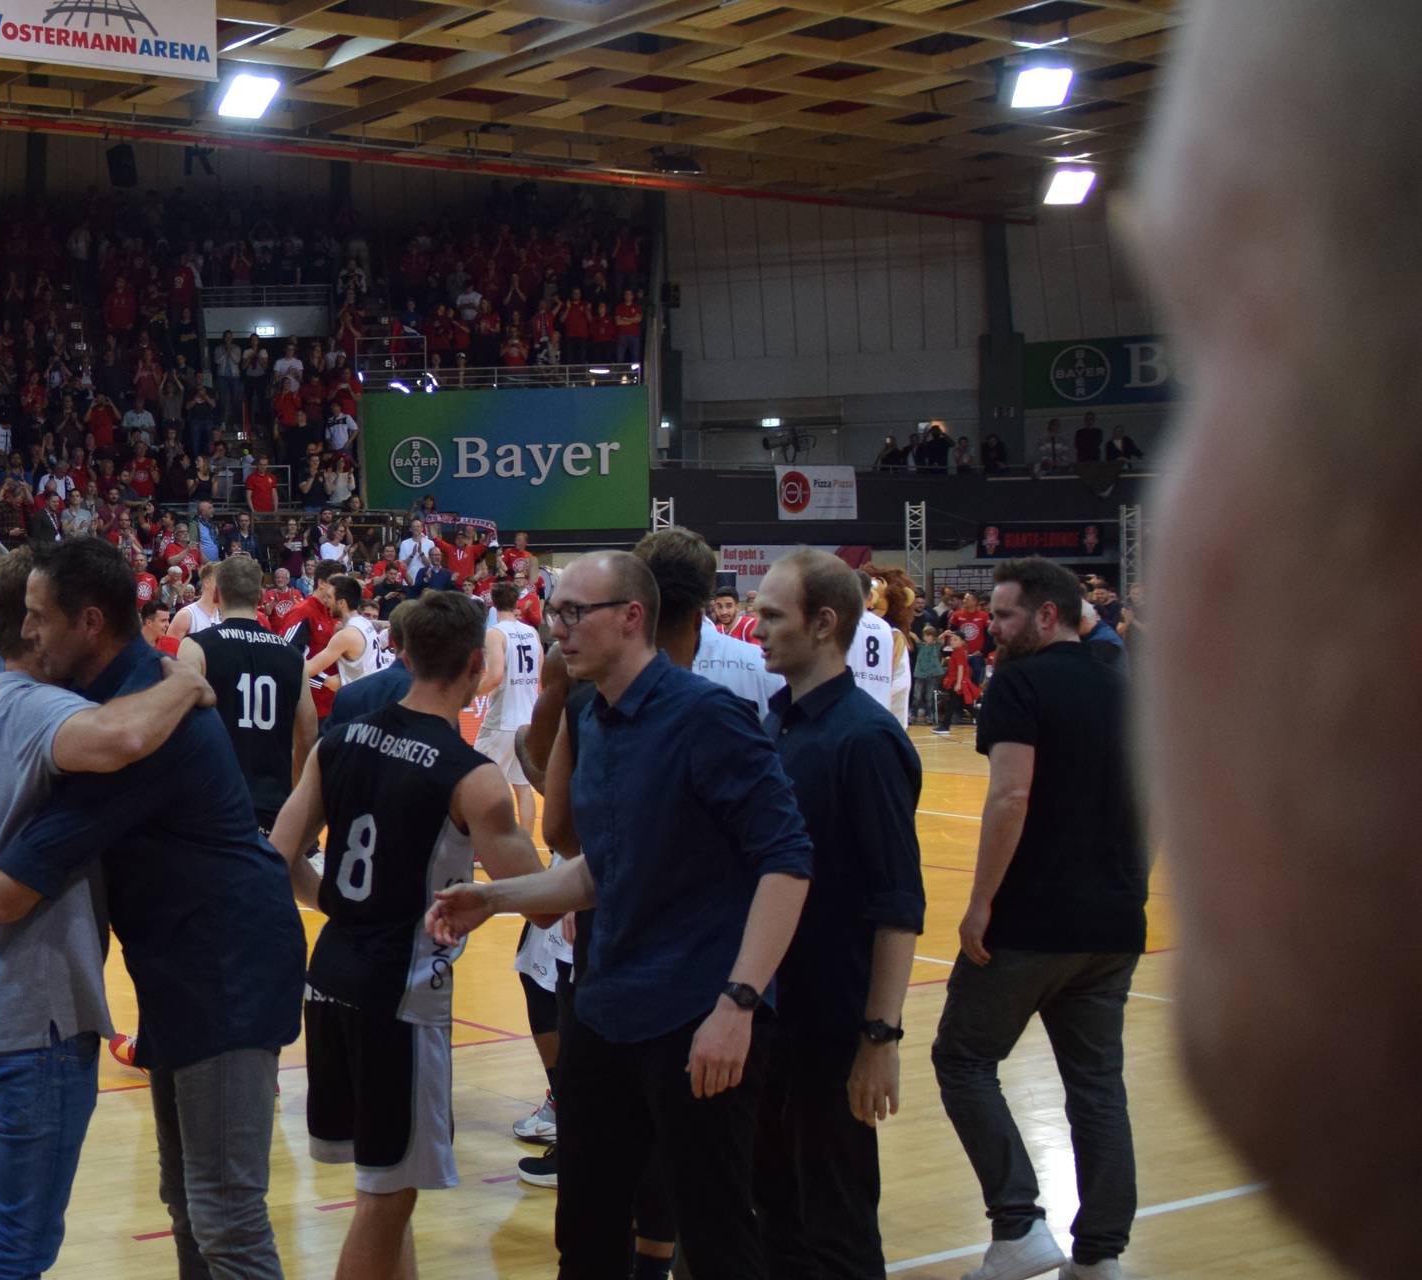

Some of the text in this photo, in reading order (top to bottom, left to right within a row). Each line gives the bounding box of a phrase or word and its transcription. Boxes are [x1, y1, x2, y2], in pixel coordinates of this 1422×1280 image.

[1055, 366, 1106, 379] BAYER
[395, 457, 438, 467] BAYER
[412, 441, 422, 484] BAYER
[452, 437, 620, 486] Bayer
[813, 479, 832, 489] Pizza
[723, 548, 737, 560] Auf
[218, 629, 287, 647] WWU BASKETS
[866, 635, 880, 668] 8
[516, 644, 534, 674] 15
[236, 672, 277, 731] 10
[345, 723, 440, 769] WWU BASKETS
[336, 812, 377, 902] 8
